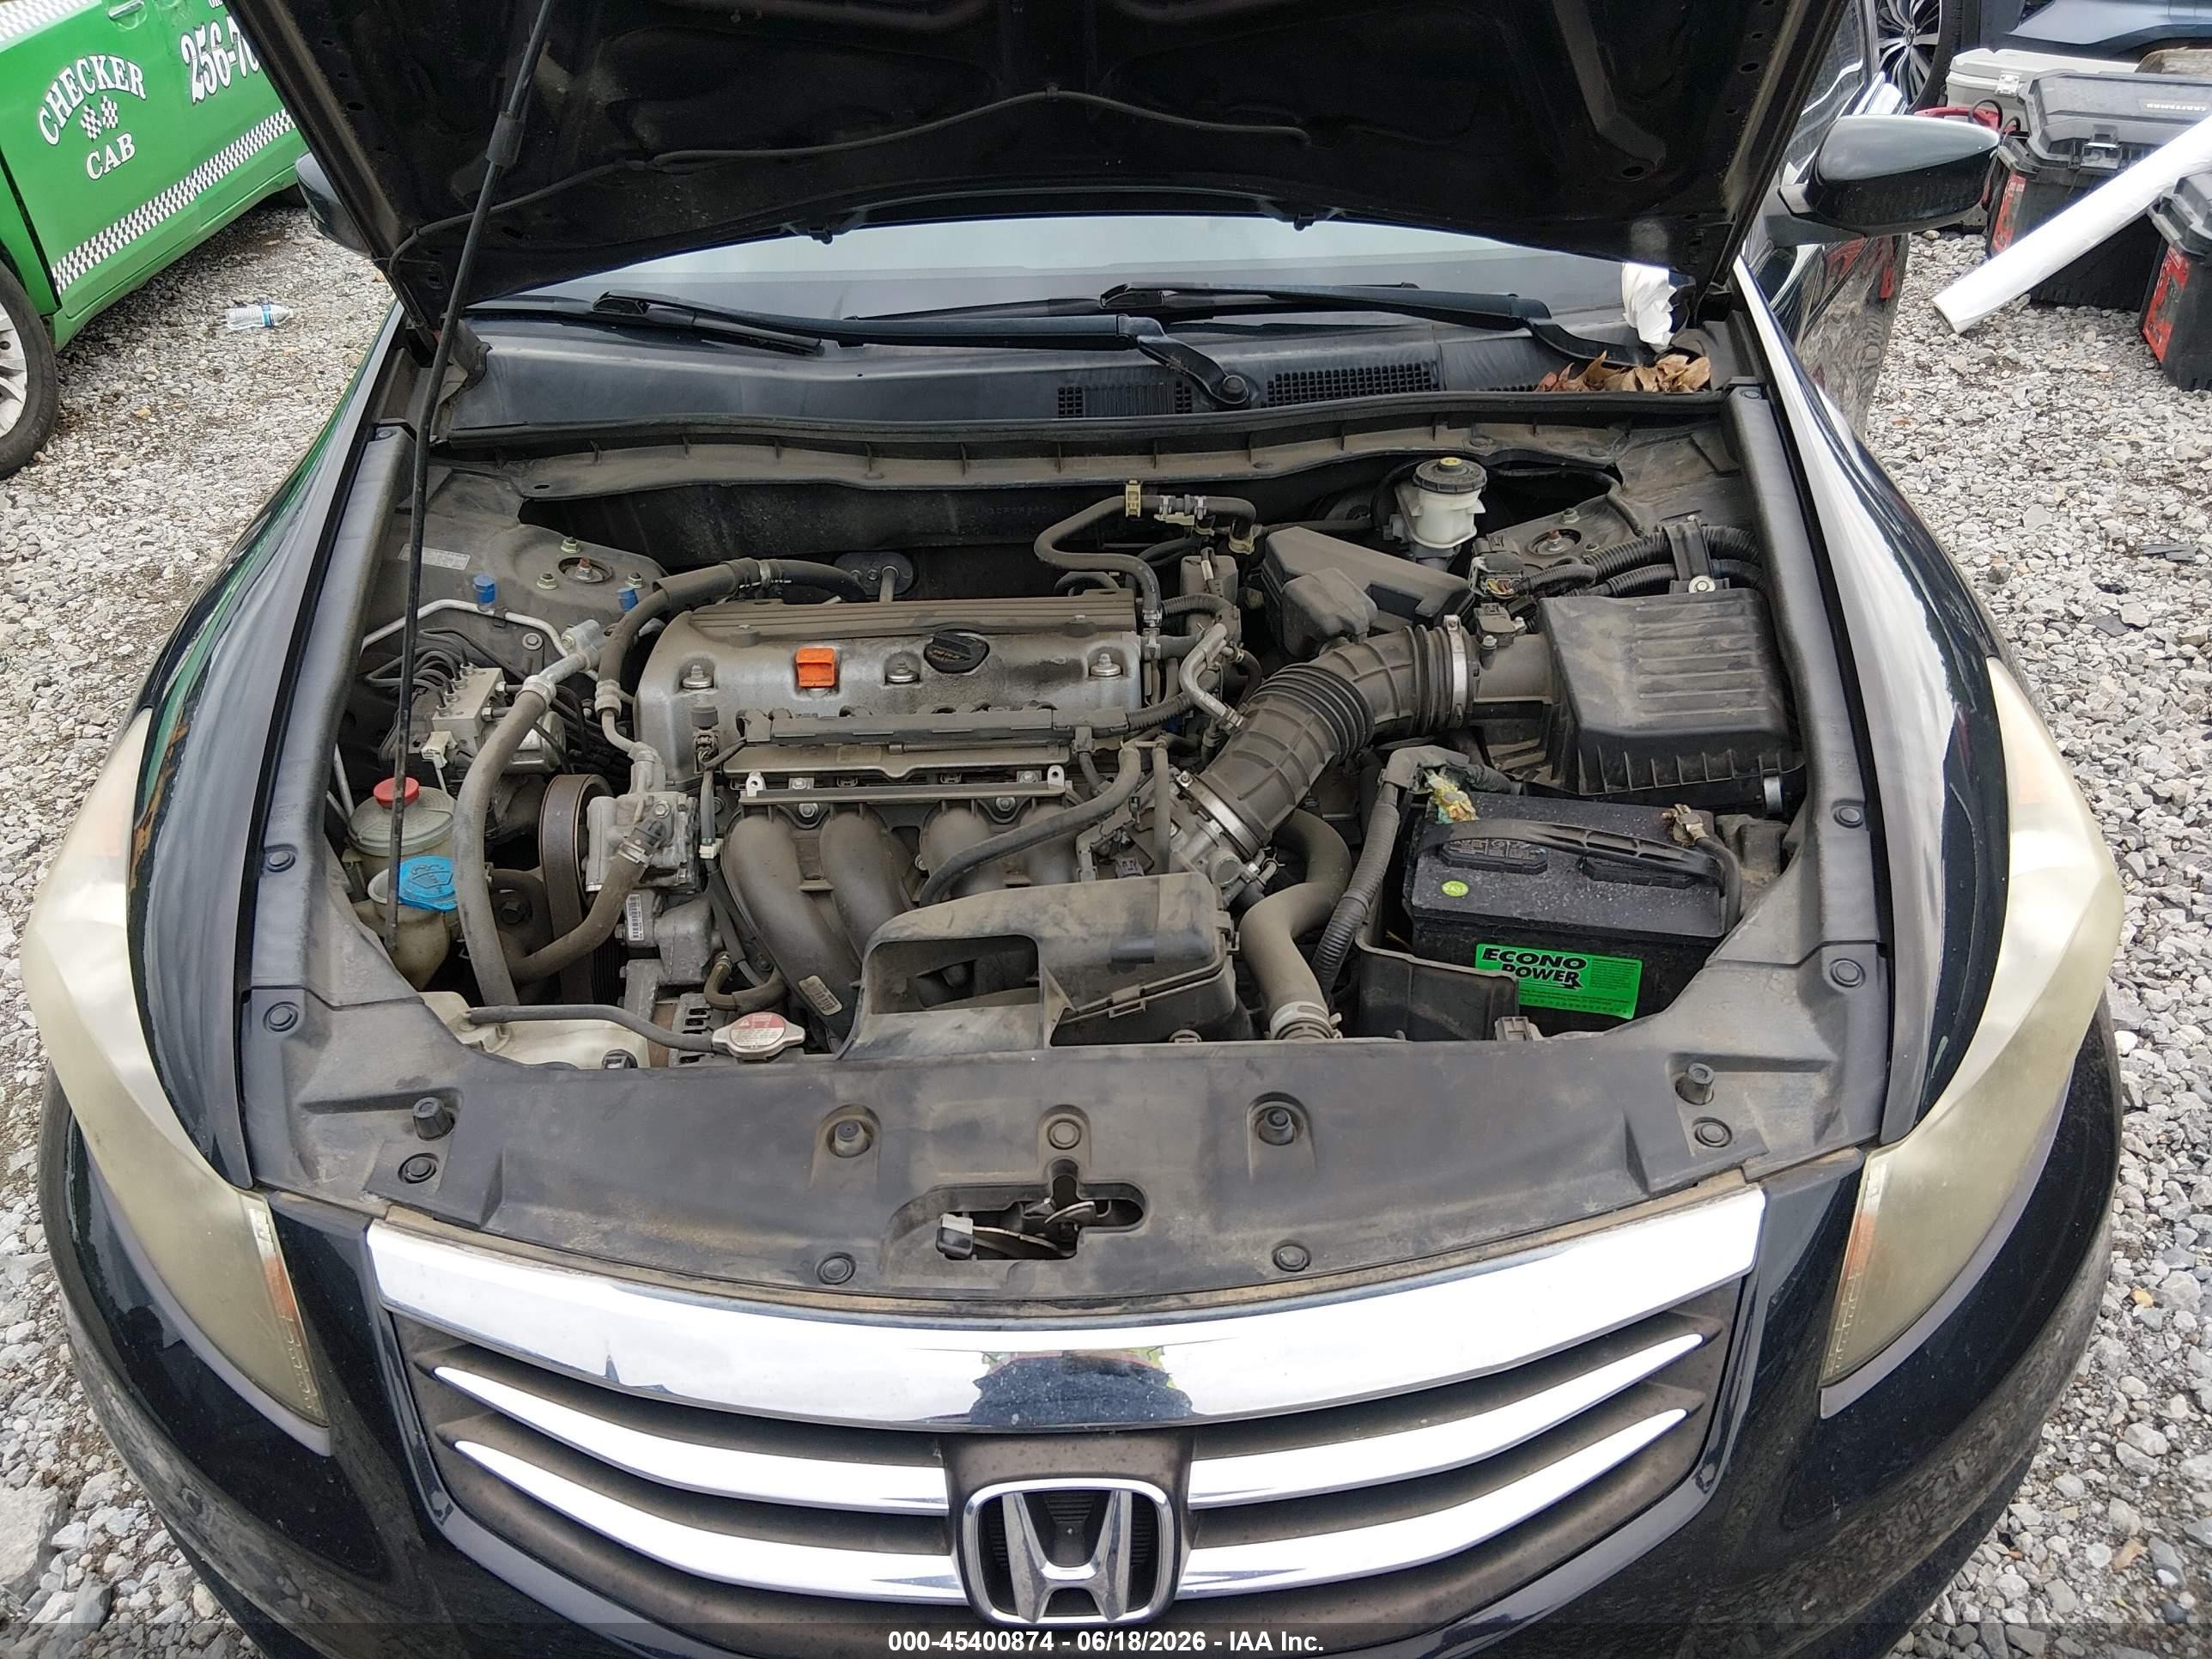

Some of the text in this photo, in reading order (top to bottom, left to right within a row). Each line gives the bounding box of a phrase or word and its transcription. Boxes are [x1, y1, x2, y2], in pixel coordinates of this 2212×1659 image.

[39, 54, 147, 145] CHECKER
[86, 132, 136, 179] CAB
[1481, 947, 1587, 970] ECONO
[1502, 963, 1583, 985] POWER
